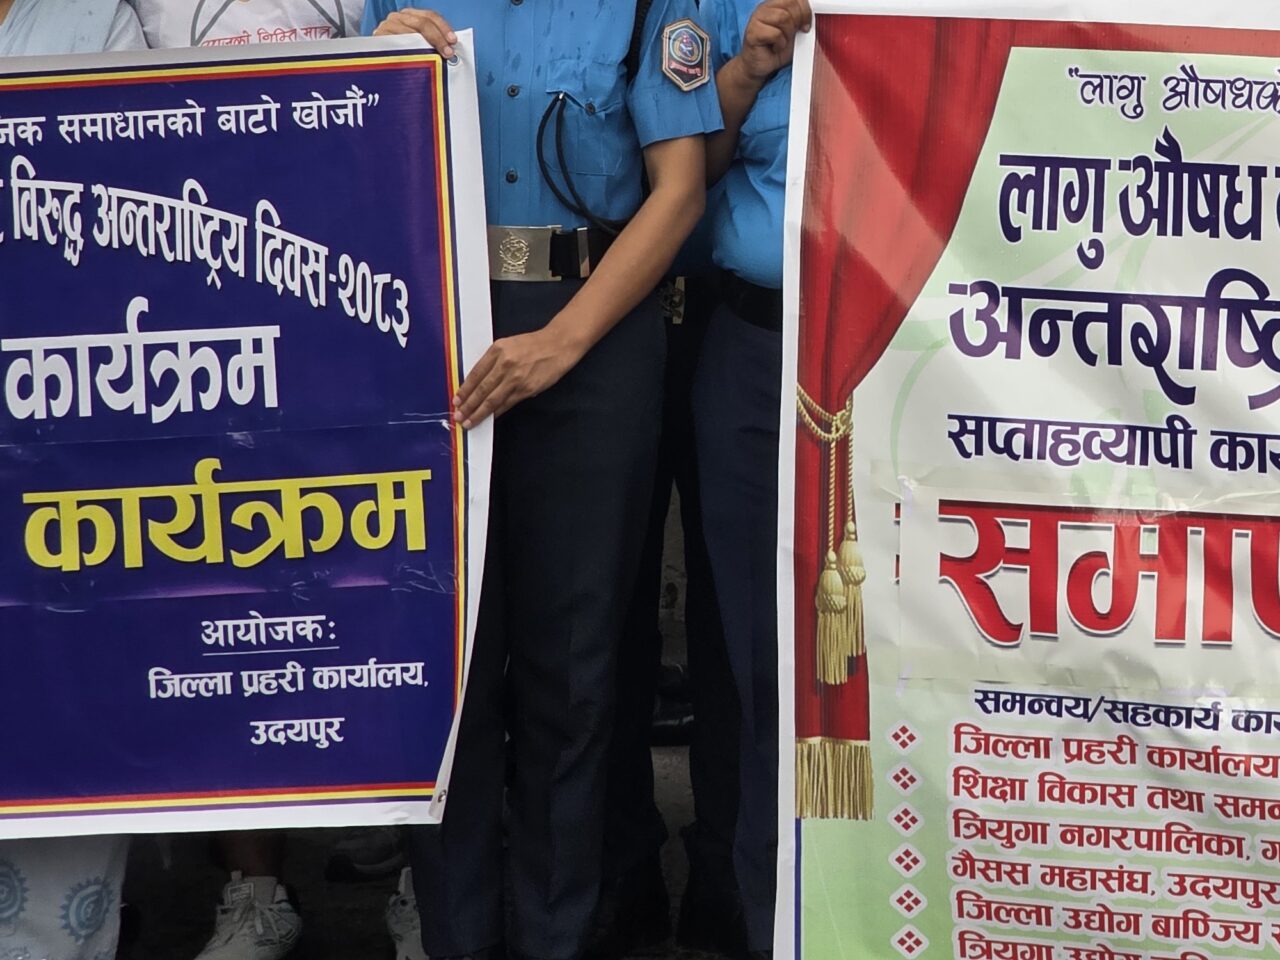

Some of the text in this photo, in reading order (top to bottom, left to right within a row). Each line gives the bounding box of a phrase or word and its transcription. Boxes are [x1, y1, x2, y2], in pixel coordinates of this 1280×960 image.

[57, 98, 206, 144] समाधानको
[217, 94, 281, 135] बाटो
[999, 153, 1113, 270] लागु
[1116, 126, 1269, 241] औषध
[0, 296, 281, 424] कार्यक्रम
[947, 414, 1199, 471] सप्ताहव्यापी
[22, 458, 433, 573] कार्यक्रम
[200, 610, 337, 647] आयोजक:
[148, 657, 430, 699] जिल्ला प्रहरी कार्यालय,
[249, 717, 346, 749] उदयपुर
[953, 723, 1053, 759] जिल्ला
[1062, 734, 1138, 765] प्रहरी
[952, 766, 1029, 804] शिक्षा
[1037, 771, 1138, 808] विकास
[1146, 786, 1206, 814] तथा
[952, 809, 1051, 850] त्रियुगा
[1059, 821, 1251, 862] नगरपालिका,
[952, 849, 1032, 886] गैसस
[1039, 865, 1156, 897] महासंघ,
[956, 890, 1054, 927] जिल्ला
[1062, 903, 1143, 936] उद्योग
